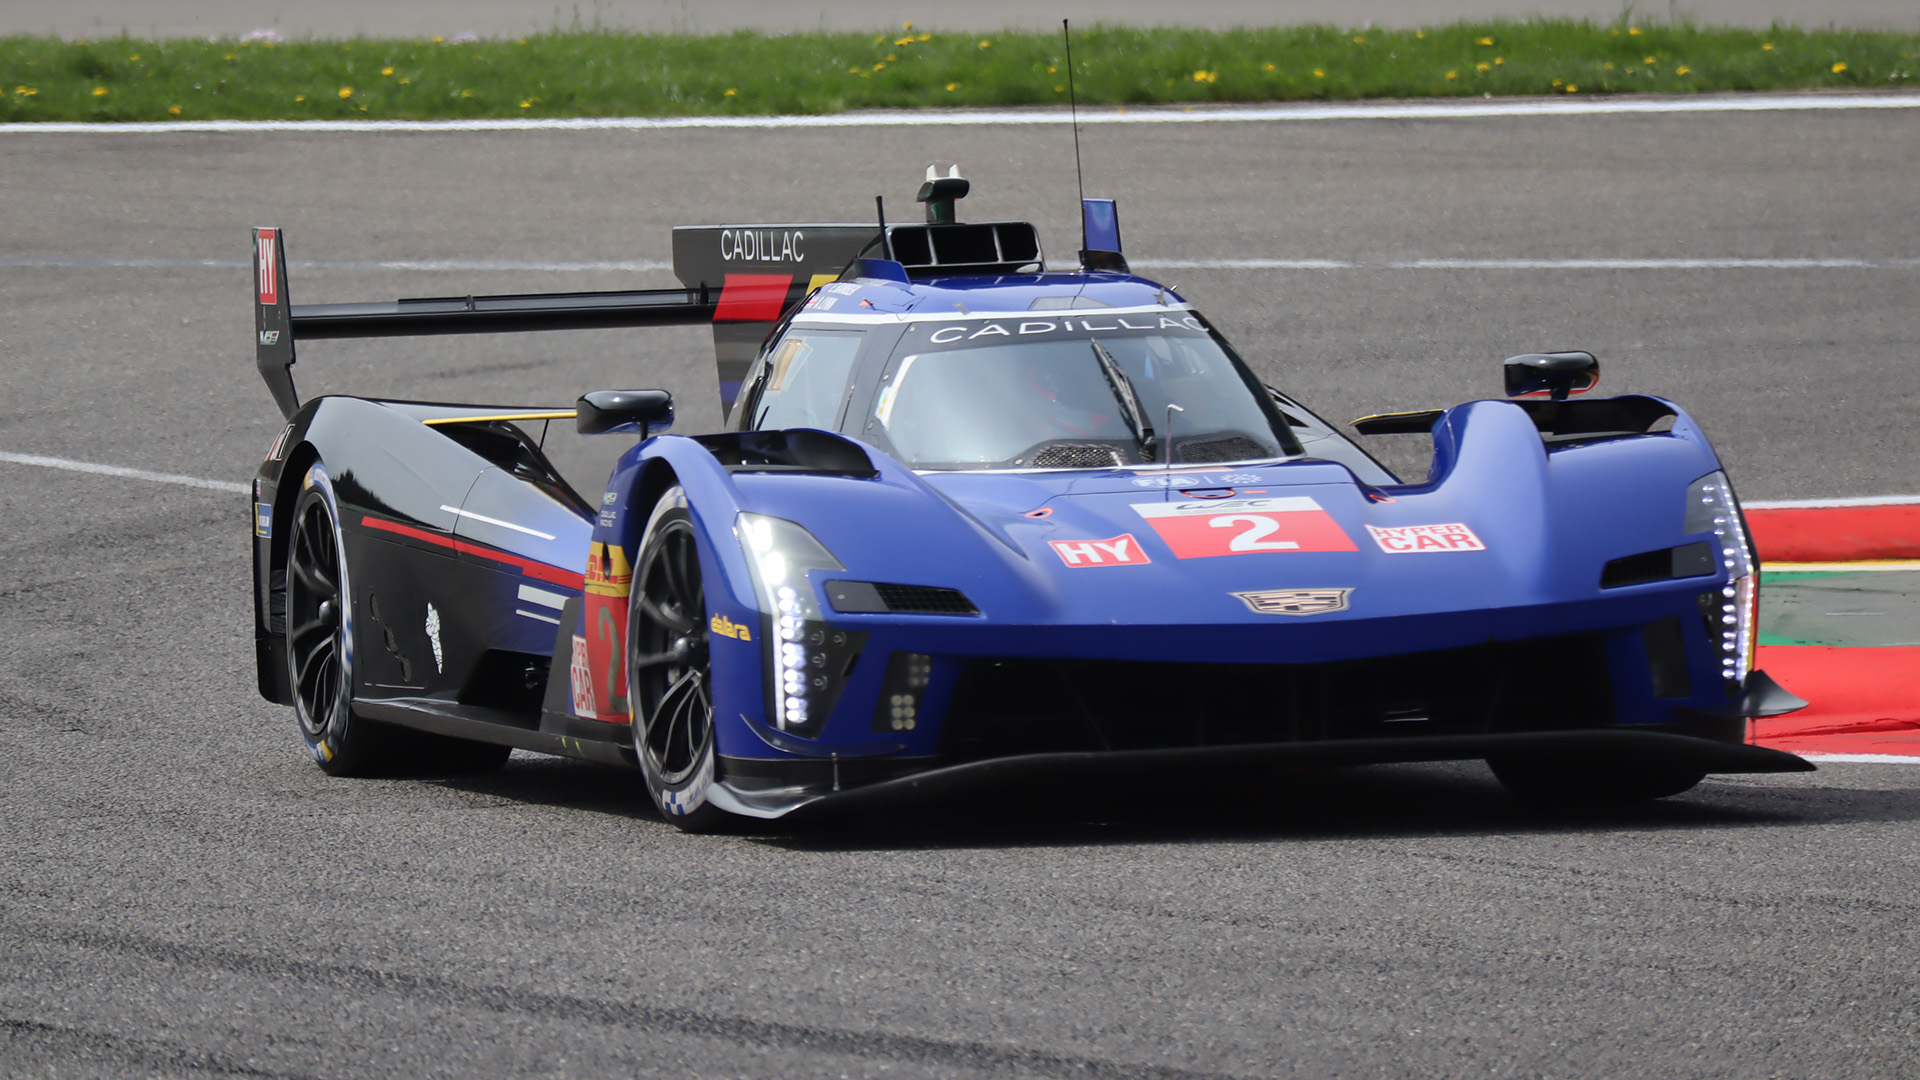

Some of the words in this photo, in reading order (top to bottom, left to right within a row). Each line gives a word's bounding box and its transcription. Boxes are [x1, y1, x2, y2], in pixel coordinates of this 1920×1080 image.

[720, 230, 805, 262] CADILLAC
[259, 239, 274, 294] HY
[929, 317, 1210, 344] CADILLAC
[1208, 515, 1301, 552] 2
[1371, 525, 1467, 537] HYPER
[1380, 533, 1479, 551] CAR
[1055, 538, 1131, 565] HY
[598, 605, 629, 713] 2
